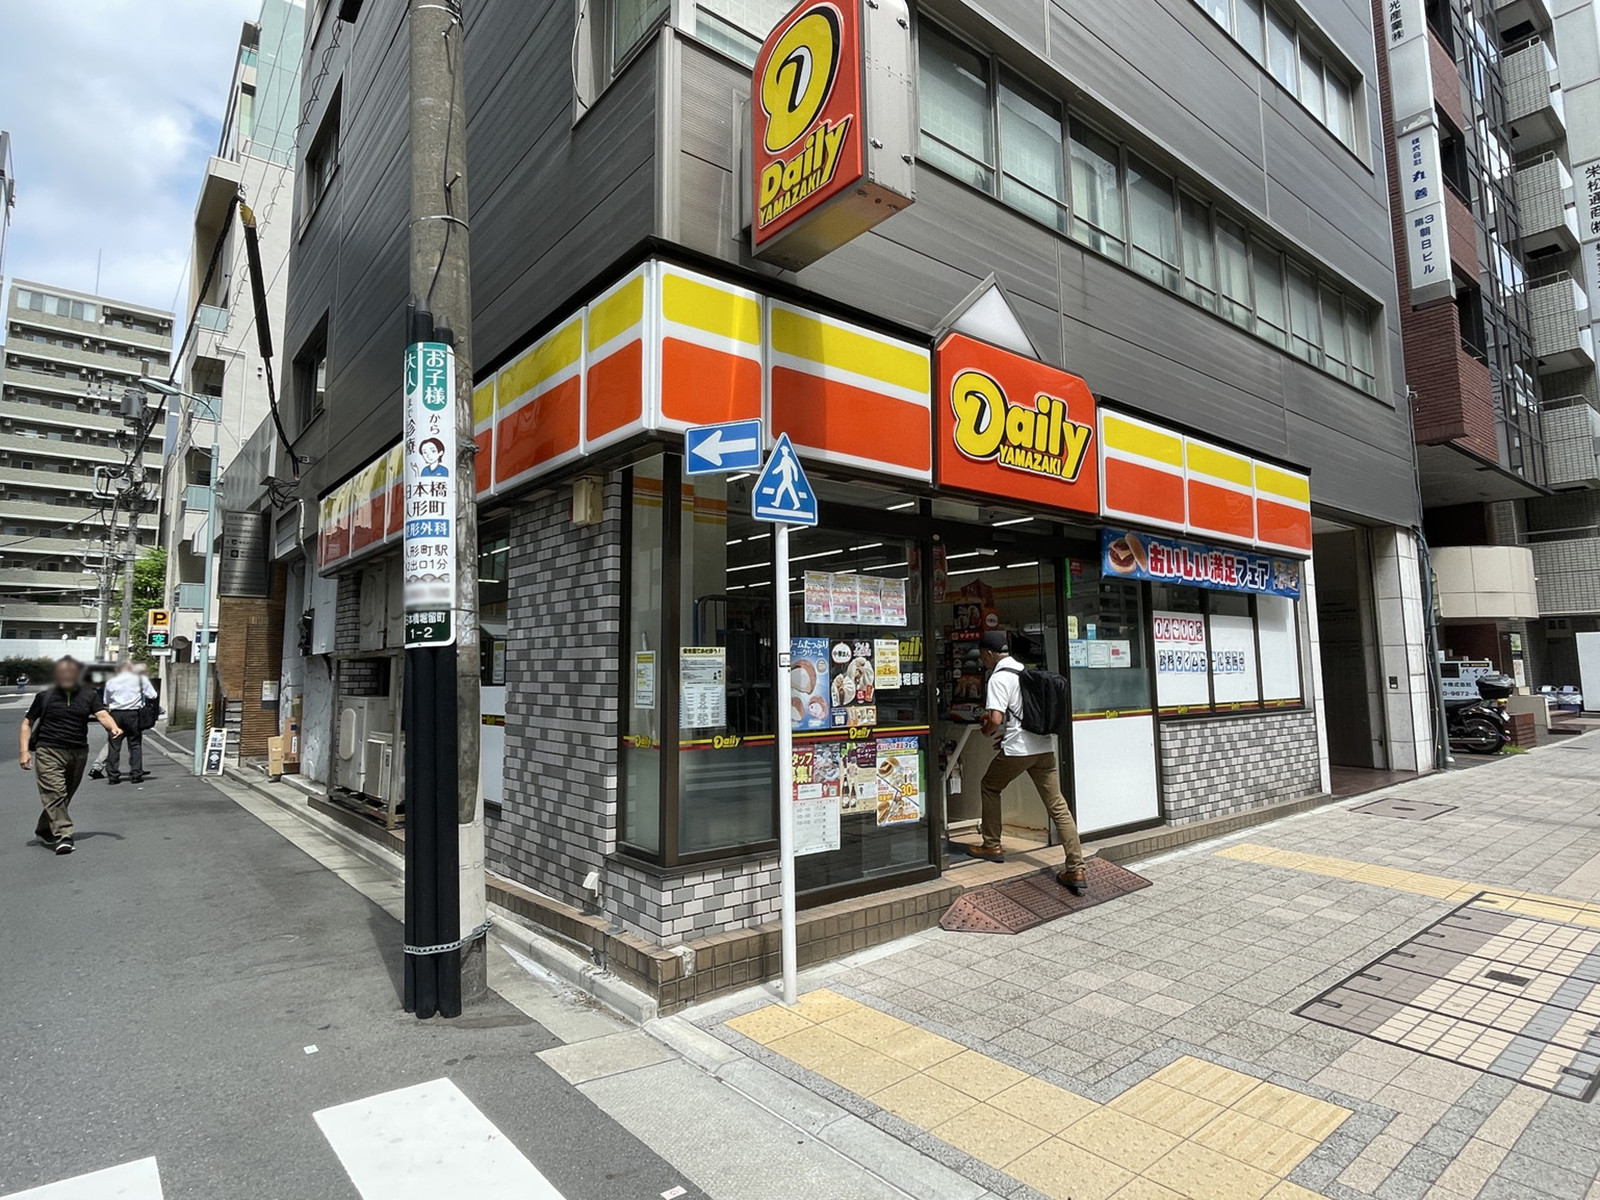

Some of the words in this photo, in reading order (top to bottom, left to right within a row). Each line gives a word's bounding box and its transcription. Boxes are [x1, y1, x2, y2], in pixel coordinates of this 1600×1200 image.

[760, 116, 851, 208] Daily
[759, 169, 822, 227] YAMAZAKI
[952, 371, 1092, 480] Daily
[999, 444, 1062, 476] YAMAZAKI
[407, 521, 448, 539] 形外科
[1149, 543, 1269, 590] おいしい満足フェア
[153, 612, 167, 625] P
[410, 626, 433, 639] 1-2
[712, 735, 741, 749] Daily
